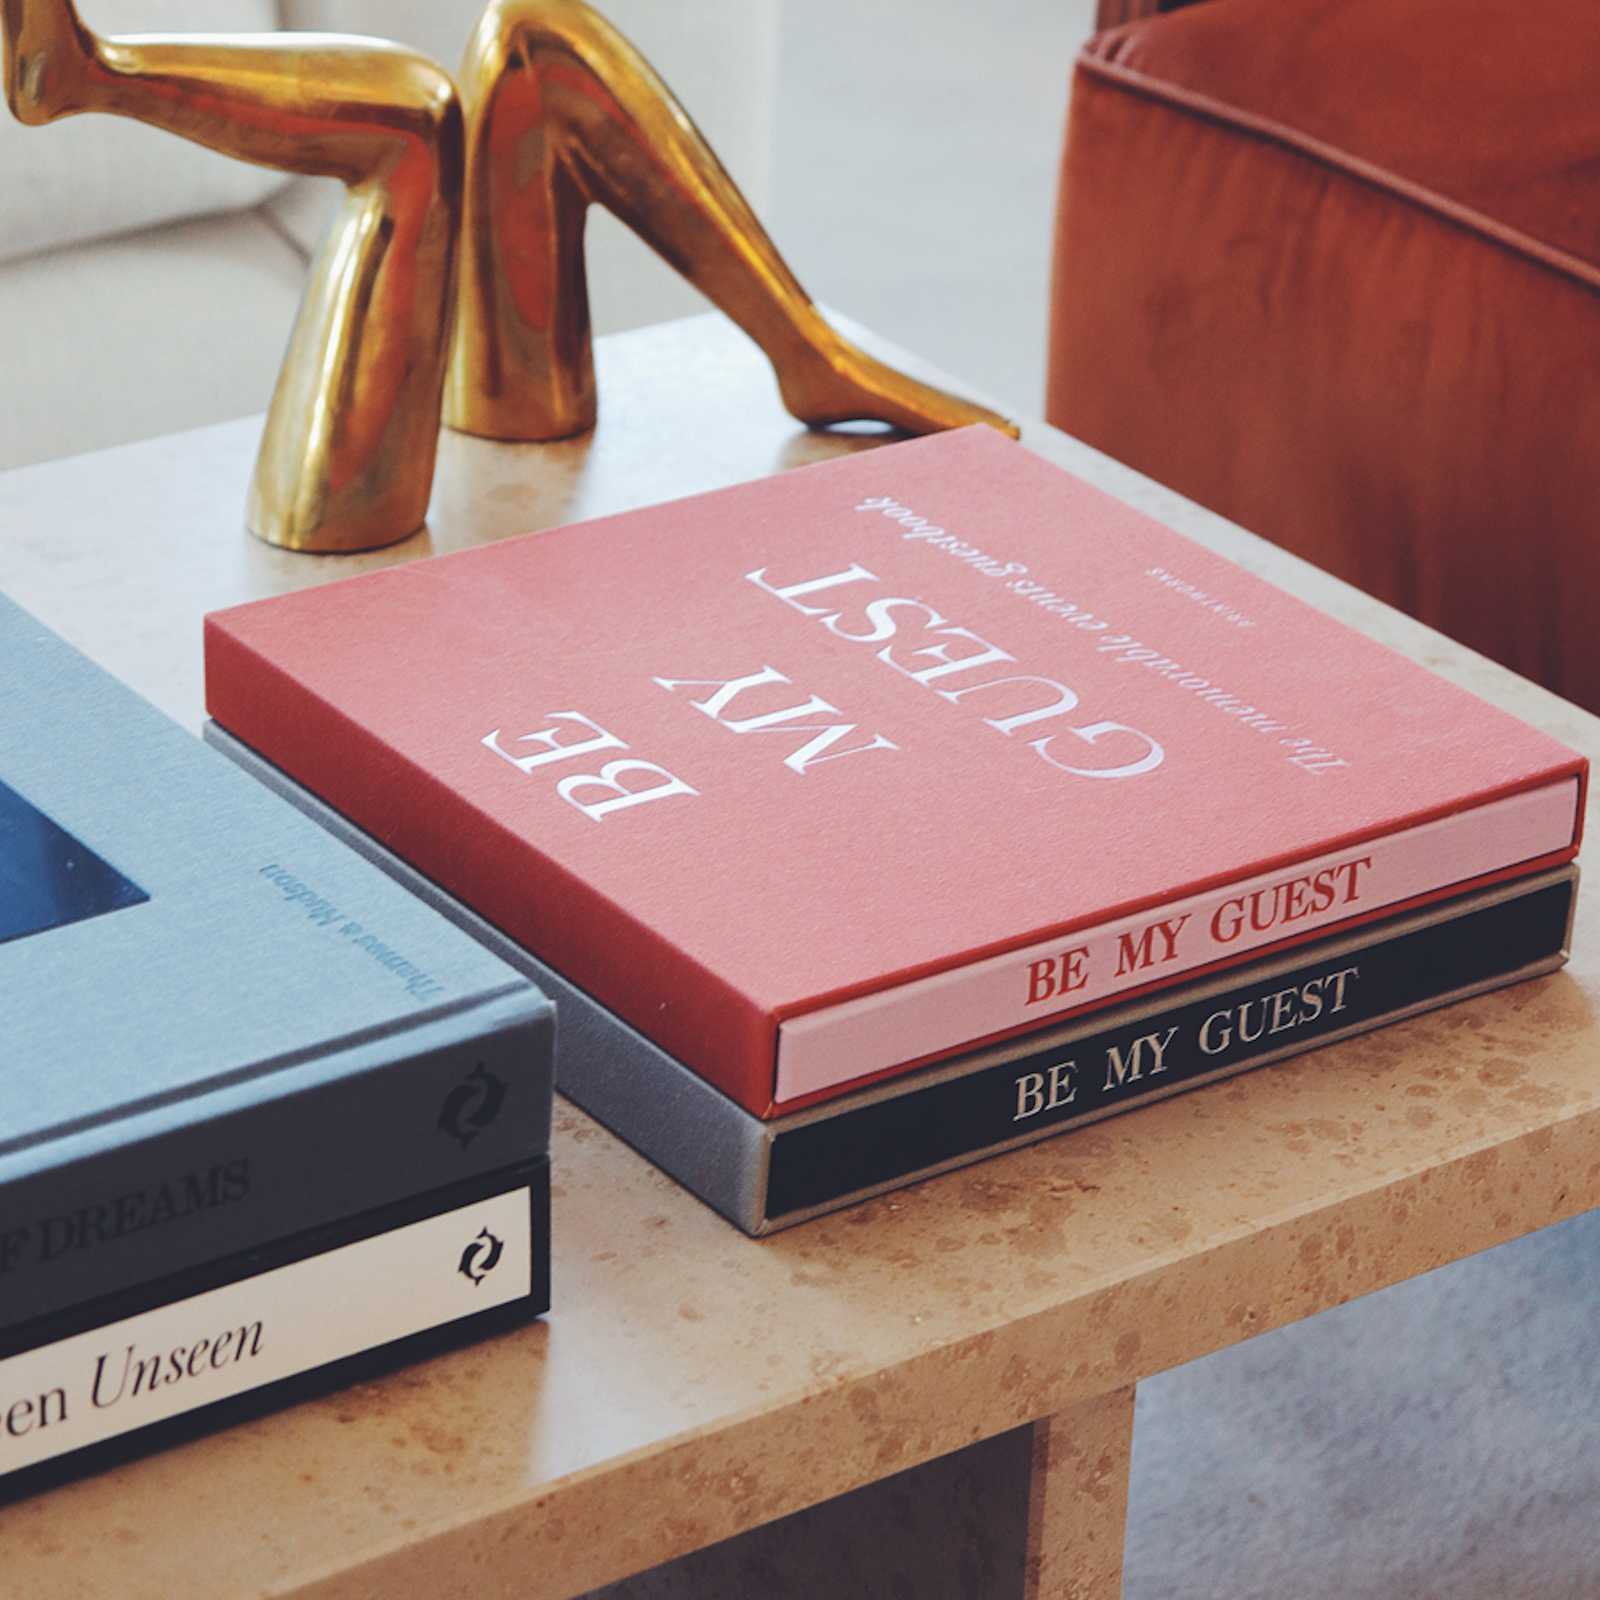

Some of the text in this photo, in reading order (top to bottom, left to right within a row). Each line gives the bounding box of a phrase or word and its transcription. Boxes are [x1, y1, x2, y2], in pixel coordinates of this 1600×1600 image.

[745, 562, 1164, 778] GUEST
[855, 497, 1349, 775] The memorable events guestbook
[480, 710, 700, 822] BE
[652, 664, 900, 775] MY
[259, 864, 347, 926] Hudson
[1025, 857, 1372, 1005] BE MY GUEST
[1013, 967, 1360, 1121] BE MY GUEST
[35, 1157, 250, 1263] DREAMS
[91, 1321, 263, 1409] Unseen
